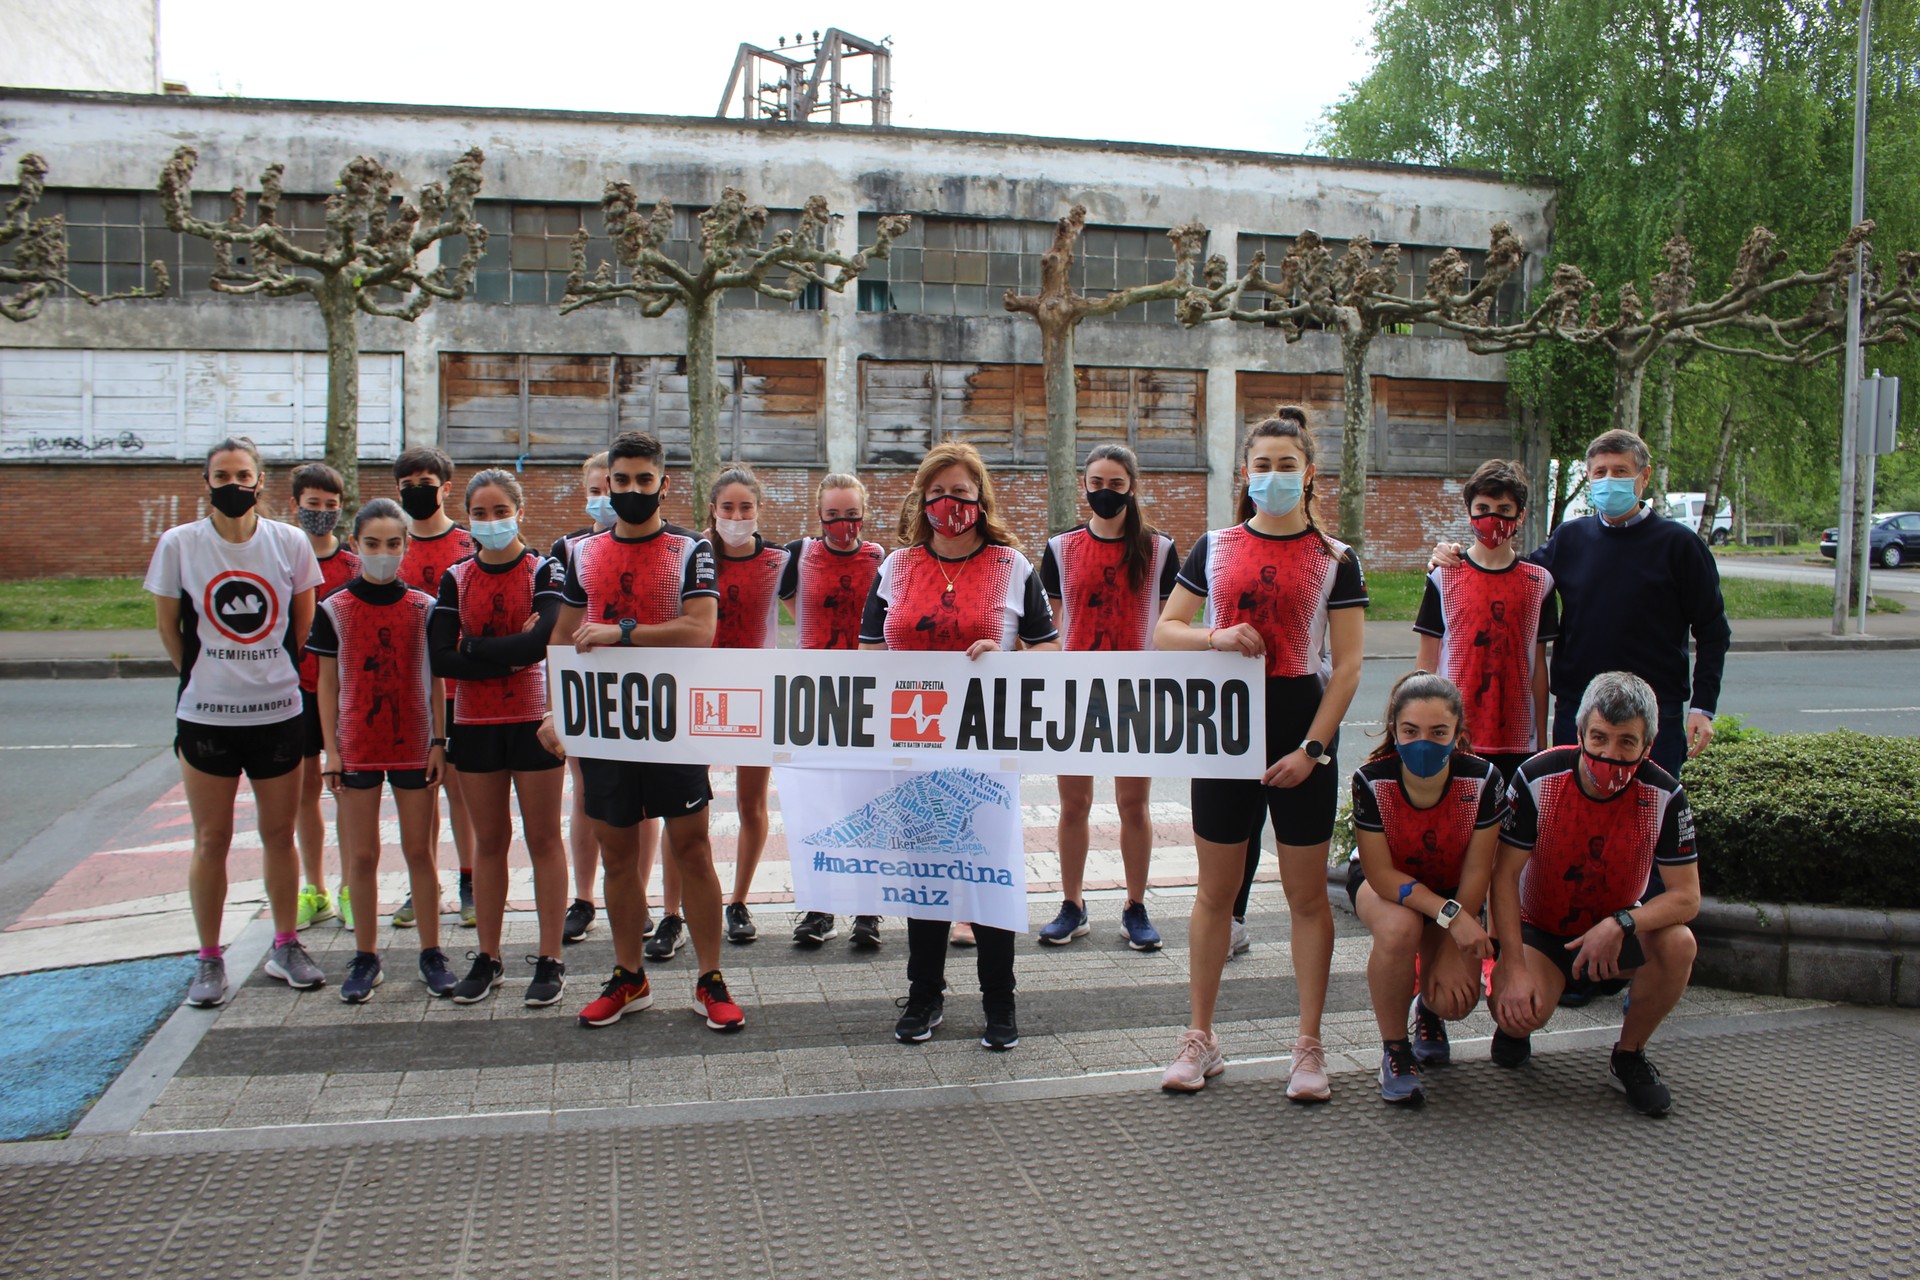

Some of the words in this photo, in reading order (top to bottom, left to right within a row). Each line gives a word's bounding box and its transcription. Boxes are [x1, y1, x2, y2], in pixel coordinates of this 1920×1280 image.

[196, 698, 292, 713] #PONTELAMANOPLA
[561, 669, 677, 742] DIEGO
[773, 675, 877, 747] IONE
[955, 677, 1250, 756] ALEJANDRO
[891, 836, 916, 850] Iker
[813, 851, 1014, 887] #mareaurdina
[882, 886, 949, 906] naiz
